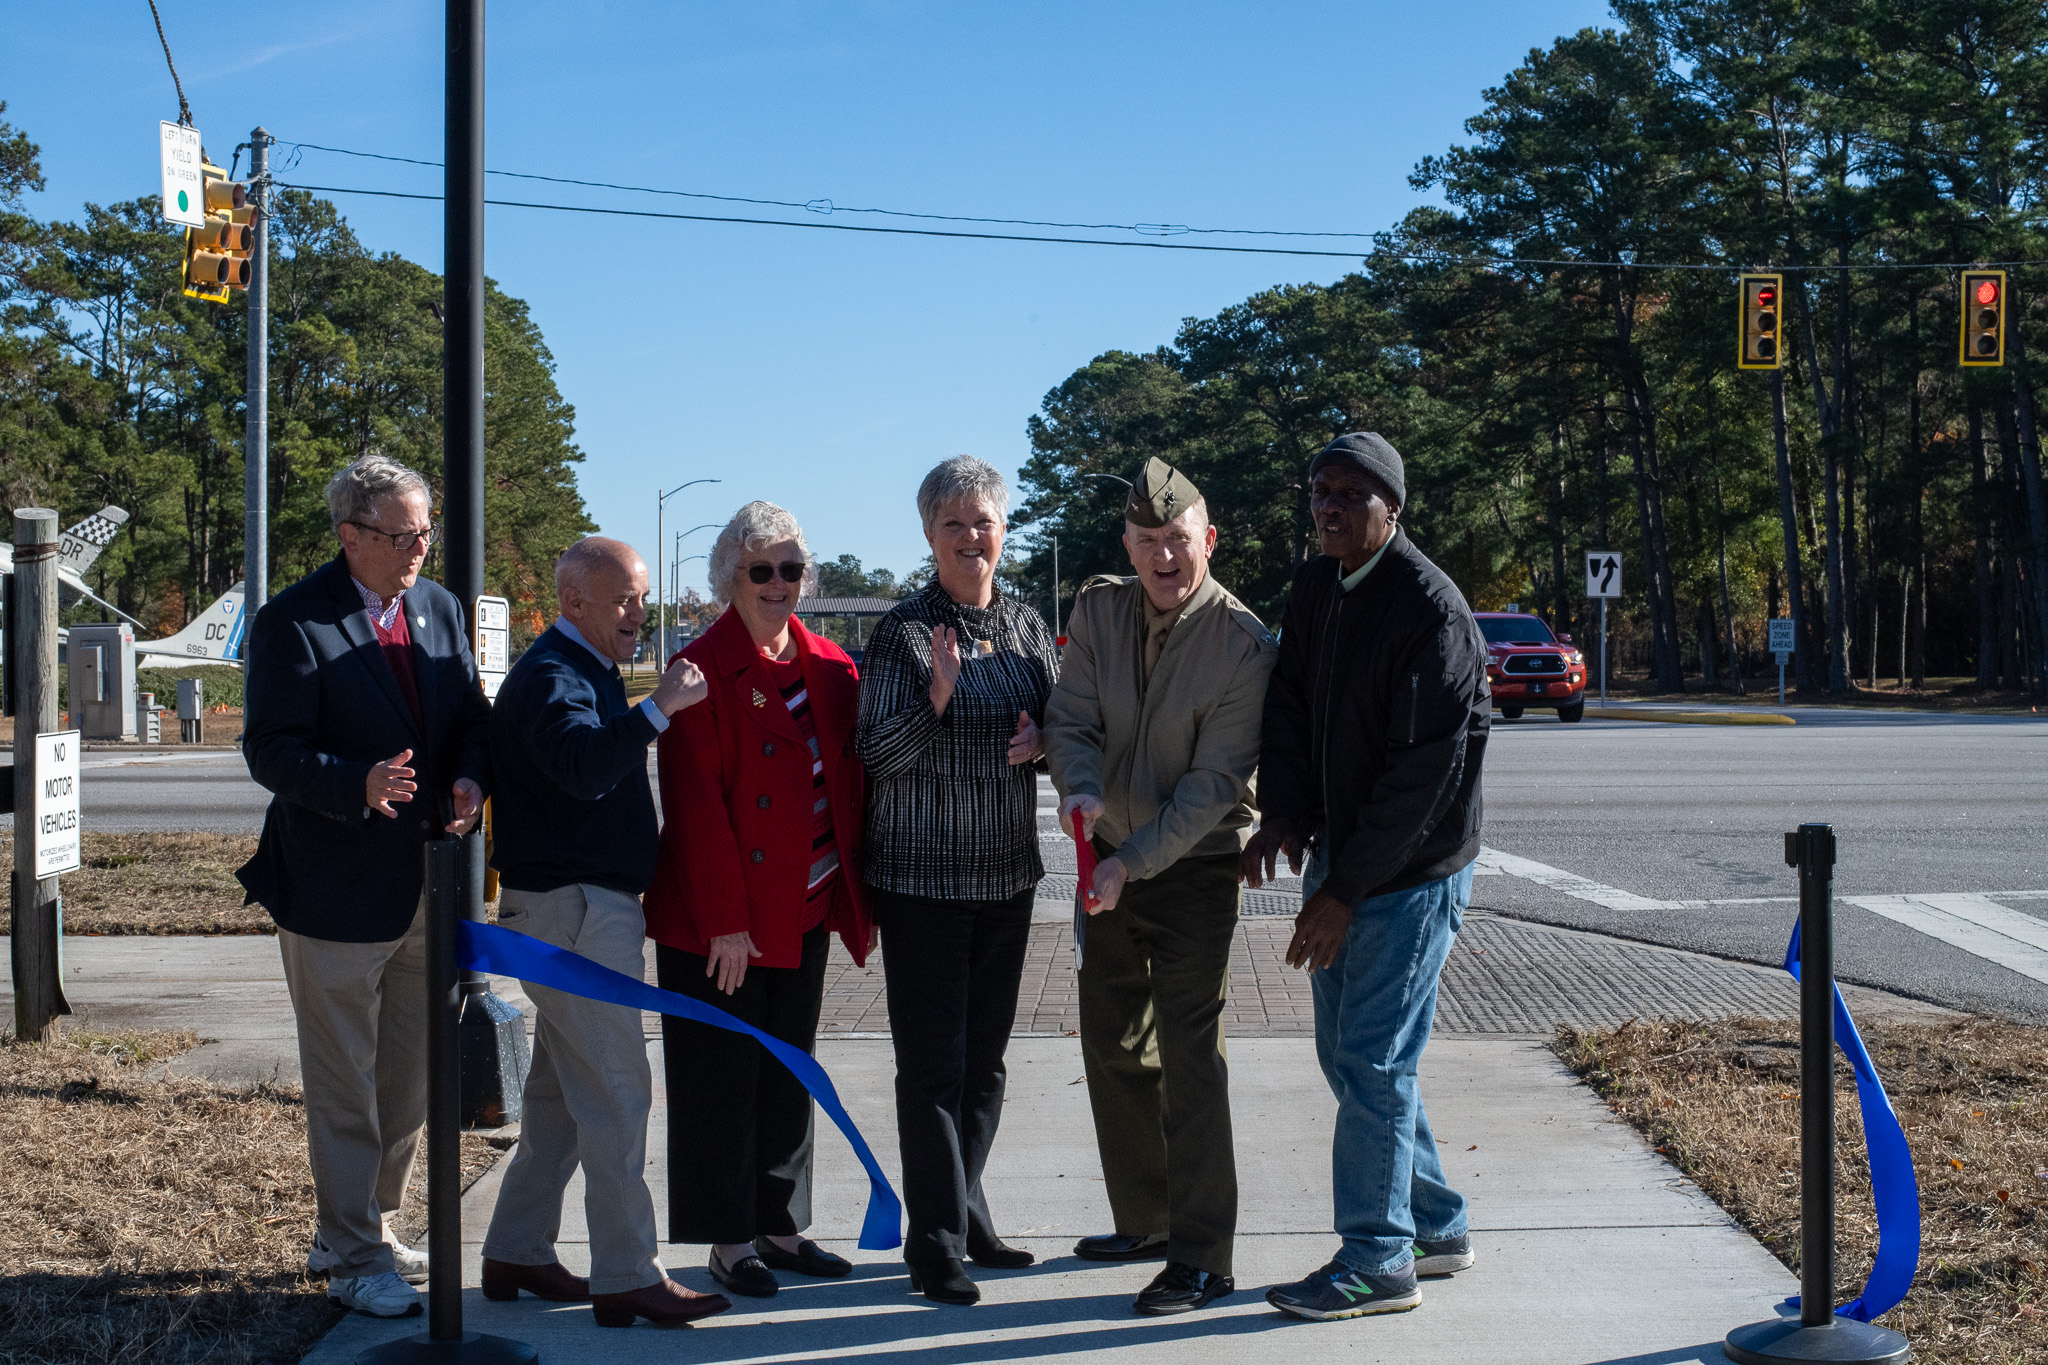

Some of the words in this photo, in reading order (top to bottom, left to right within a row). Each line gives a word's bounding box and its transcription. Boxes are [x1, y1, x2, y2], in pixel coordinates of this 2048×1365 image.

[164, 128, 178, 142] LEFT
[180, 133, 197, 146] TURN
[171, 148, 192, 164] YIELD
[166, 165, 176, 177] ON
[177, 168, 197, 181] GREEN
[59, 537, 84, 561] DR
[204, 622, 227, 641] DC
[1771, 622, 1793, 630] SPEED
[1771, 640, 1793, 648] AHEAD
[1773, 631, 1791, 640] ZONE
[186, 643, 208, 657] 6963
[54, 742, 66, 763] NO
[45, 775, 73, 799] MOTOR
[40, 809, 77, 836] VEHICLES
[346, 1276, 367, 1298] N
[1332, 1273, 1374, 1303] N
